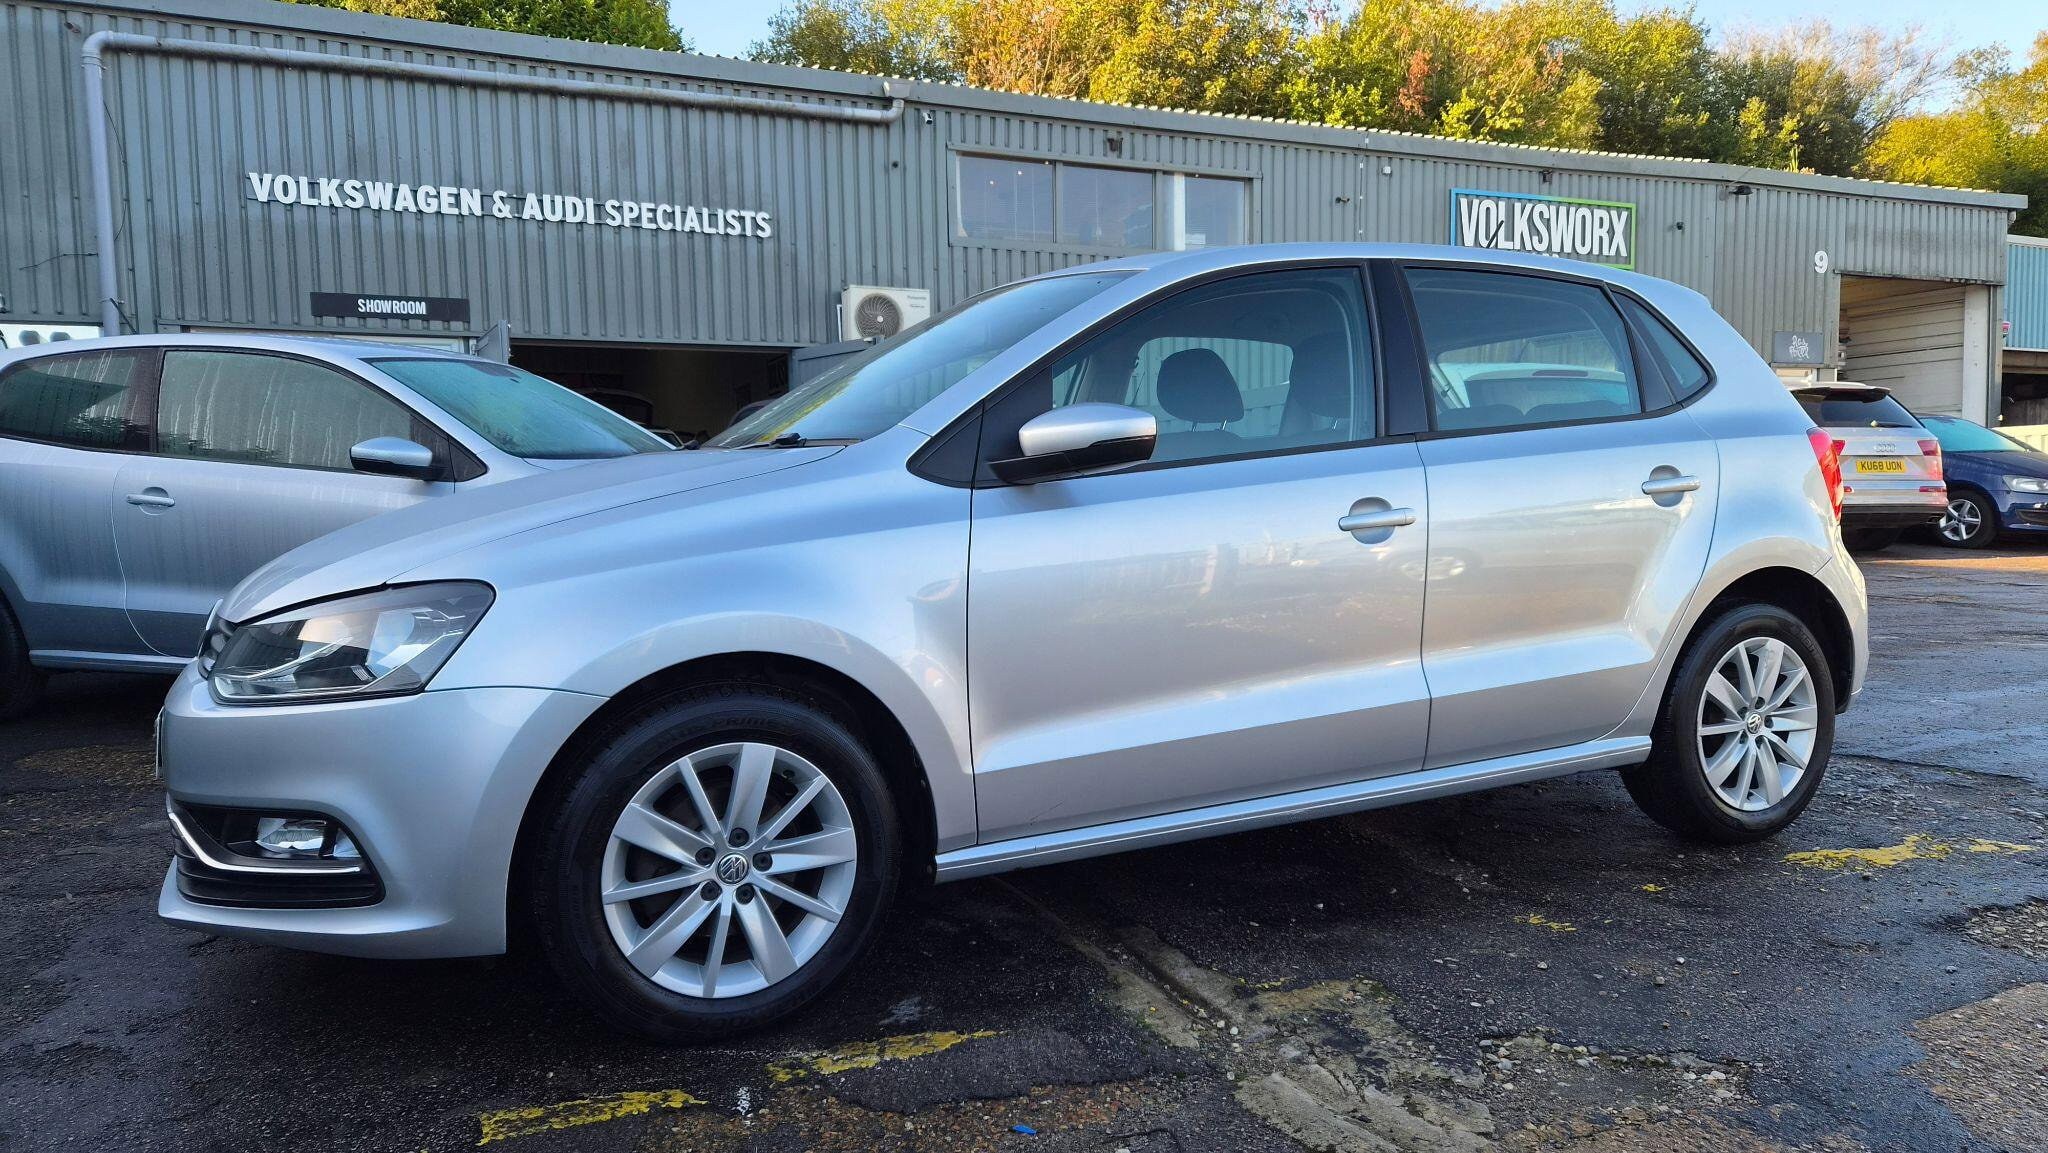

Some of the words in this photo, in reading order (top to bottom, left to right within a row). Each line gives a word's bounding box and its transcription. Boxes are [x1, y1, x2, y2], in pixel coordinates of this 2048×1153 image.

[249, 172, 482, 217] VOLKSWAGEN
[492, 190, 512, 219] &
[522, 192, 595, 225] AUDI
[605, 199, 772, 238] SPECIALISTS
[1460, 198, 1628, 257] VOLKSWORX
[1814, 250, 1829, 274] 9
[357, 298, 427, 315] SHOWROOM
[1860, 461, 1885, 471] KU68
